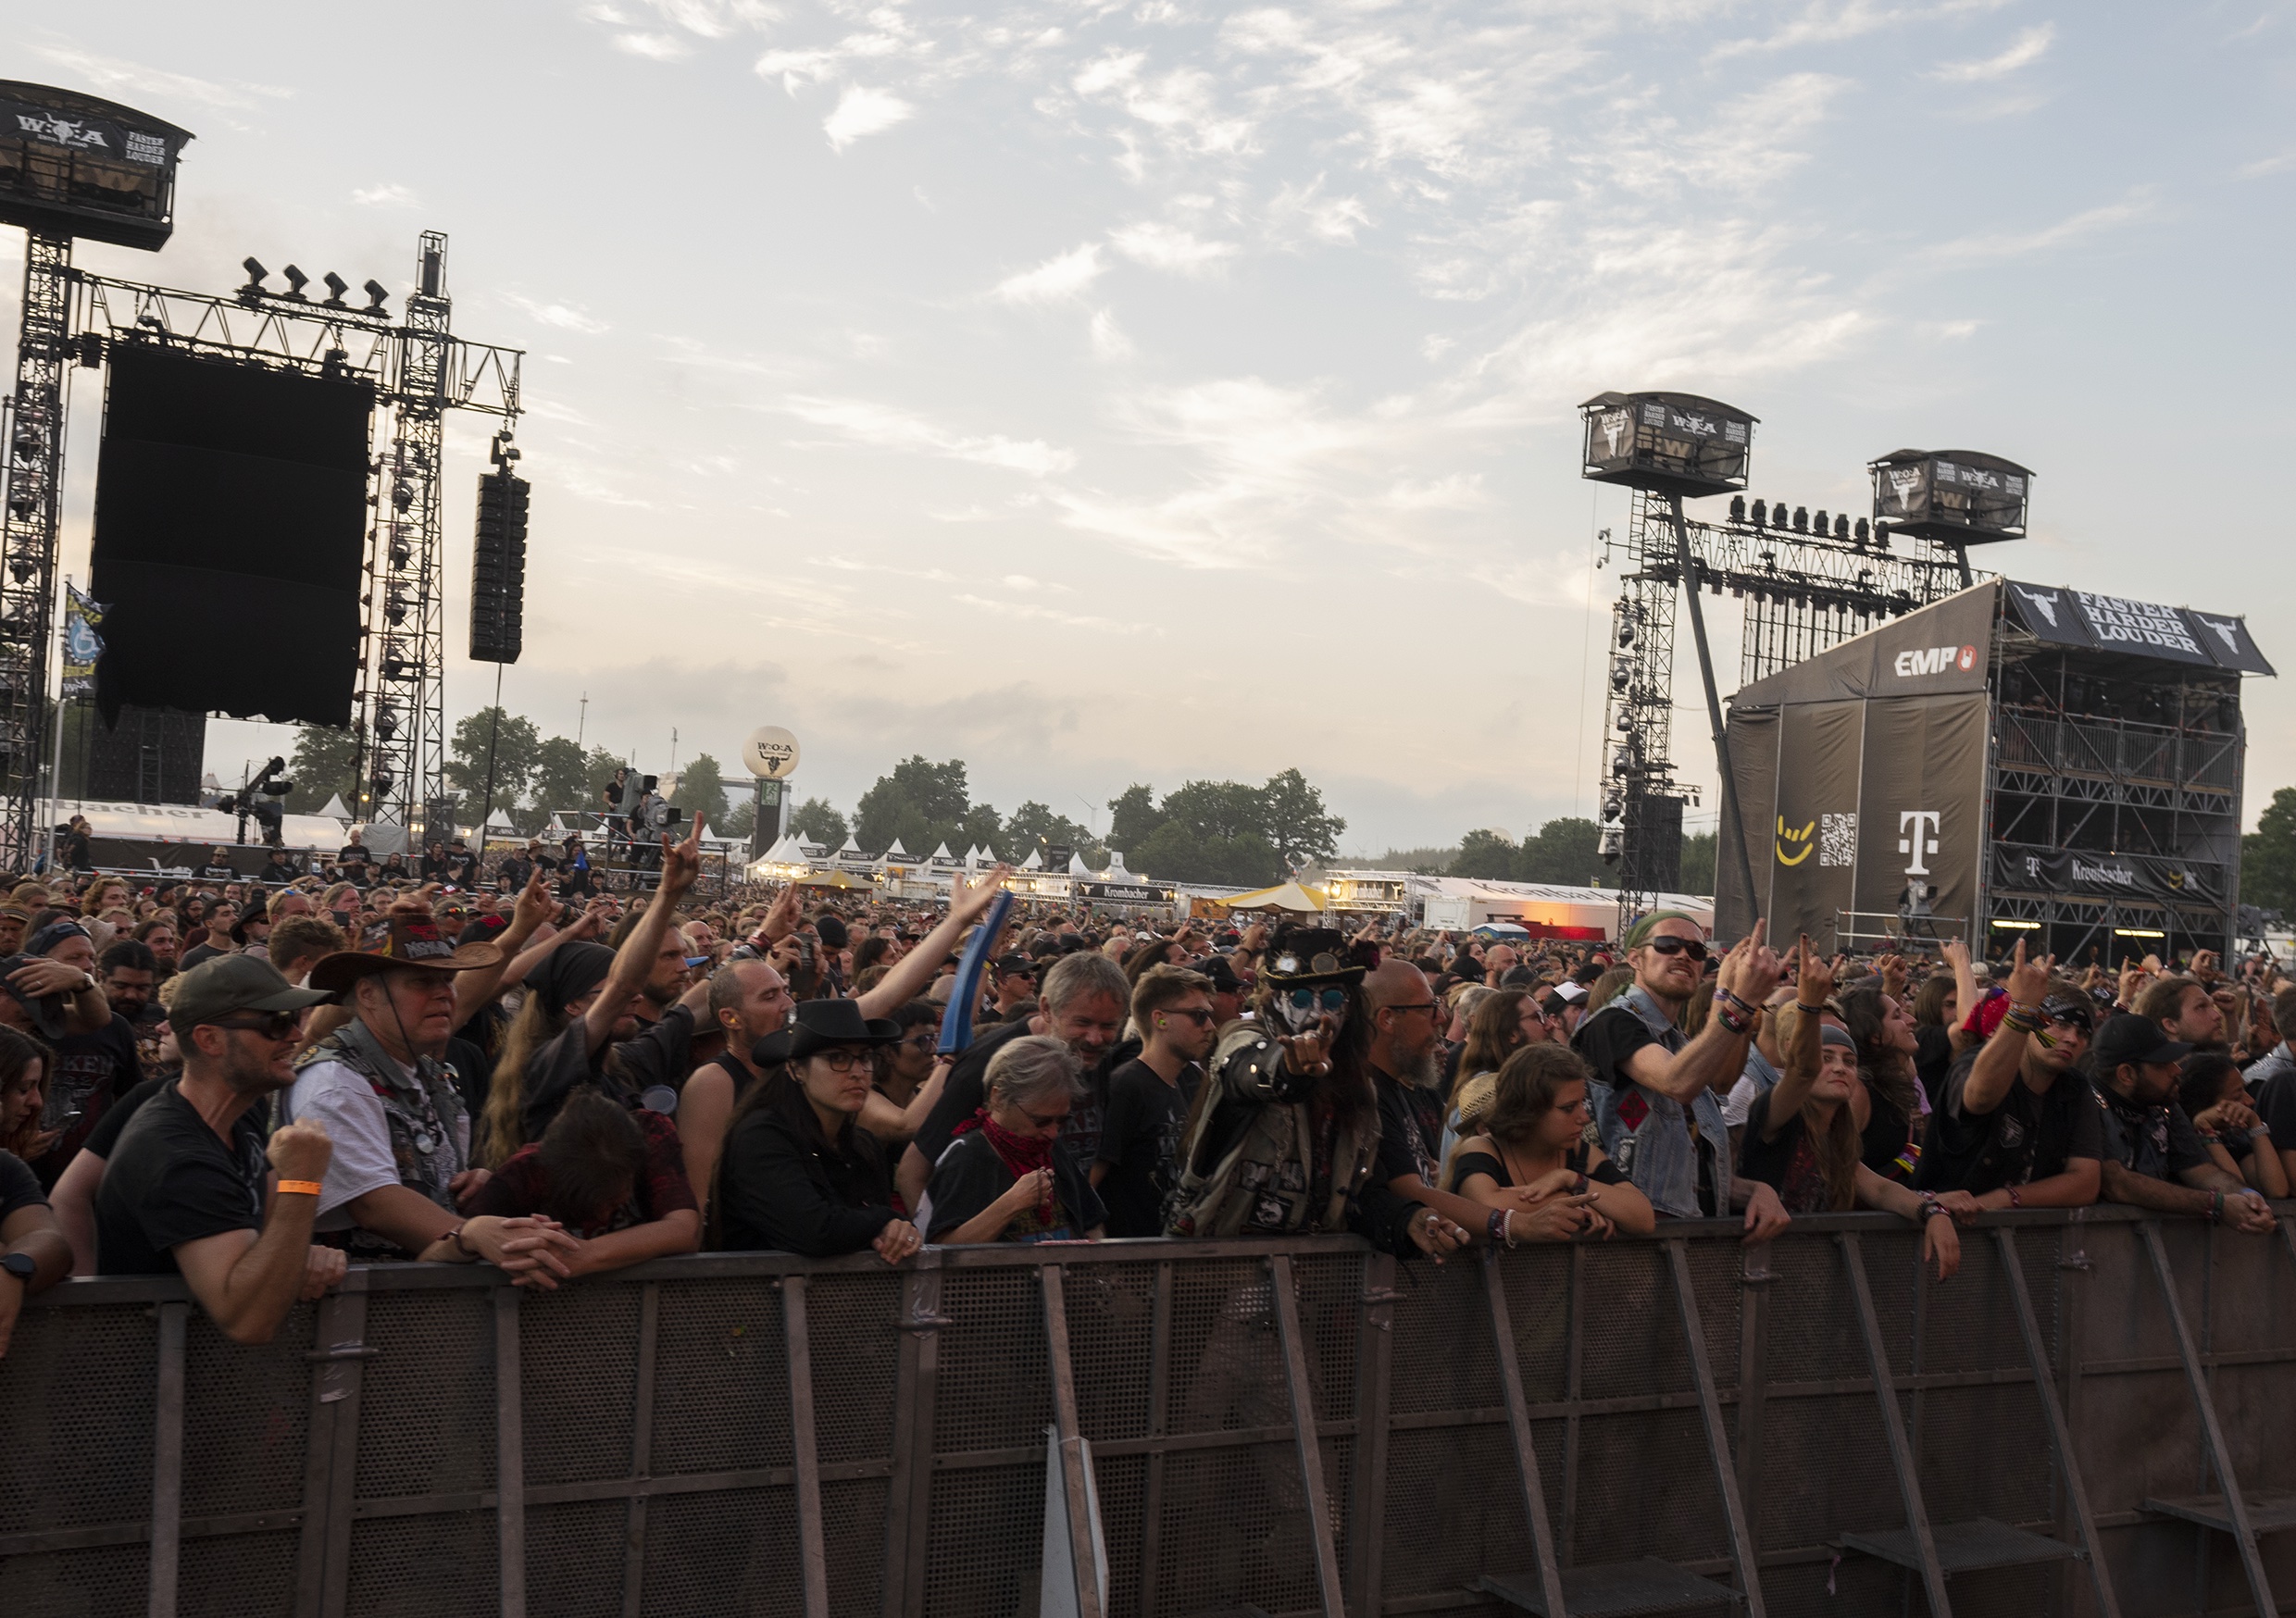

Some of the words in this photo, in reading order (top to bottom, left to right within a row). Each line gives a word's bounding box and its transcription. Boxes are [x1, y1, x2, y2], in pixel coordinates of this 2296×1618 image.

[126, 140, 166, 156] HARDER
[129, 131, 165, 148] FASTER
[125, 149, 165, 166] LOUDER
[2078, 591, 2179, 619] FASTER
[2082, 604, 2191, 637] HARDER
[2092, 622, 2203, 655] LOUDER
[1894, 647, 1958, 677] EMP
[1898, 811, 1940, 876] T
[2026, 857, 2040, 877] T
[1104, 885, 1150, 900] Krombacher
